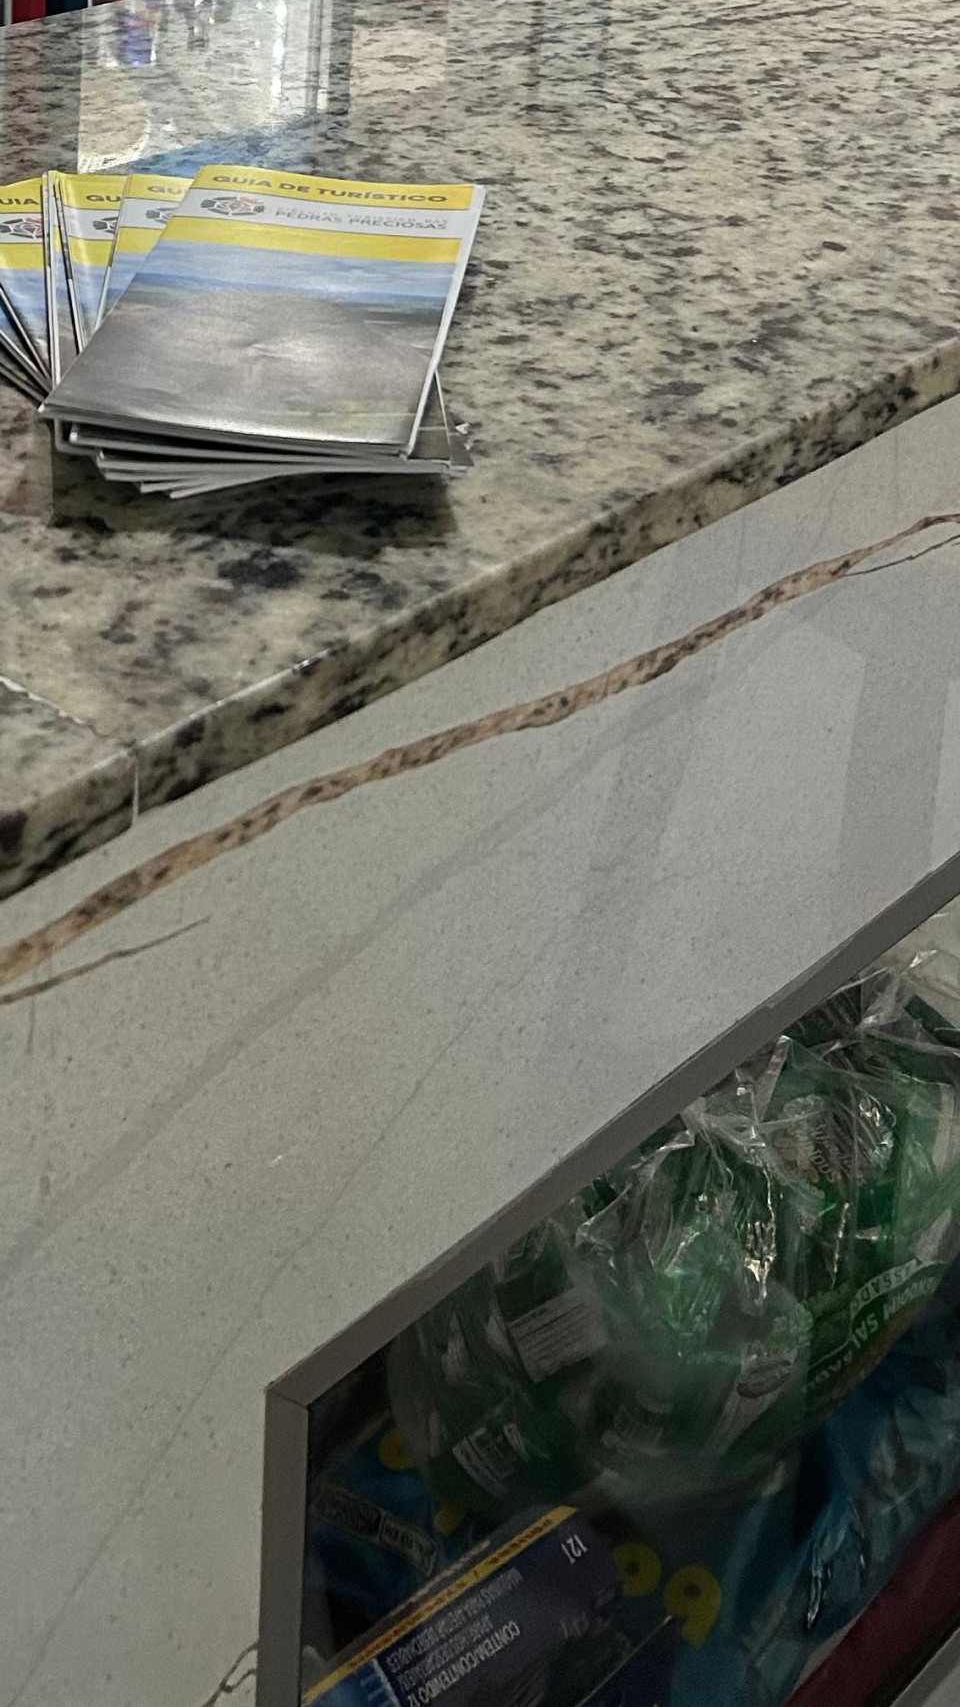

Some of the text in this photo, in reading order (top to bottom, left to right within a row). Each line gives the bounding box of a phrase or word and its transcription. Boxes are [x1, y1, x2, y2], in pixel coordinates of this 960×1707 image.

[212, 175, 448, 203] GUIA DE TURÍSTICO
[275, 210, 448, 231] PEDRAS PRECIOSAS
